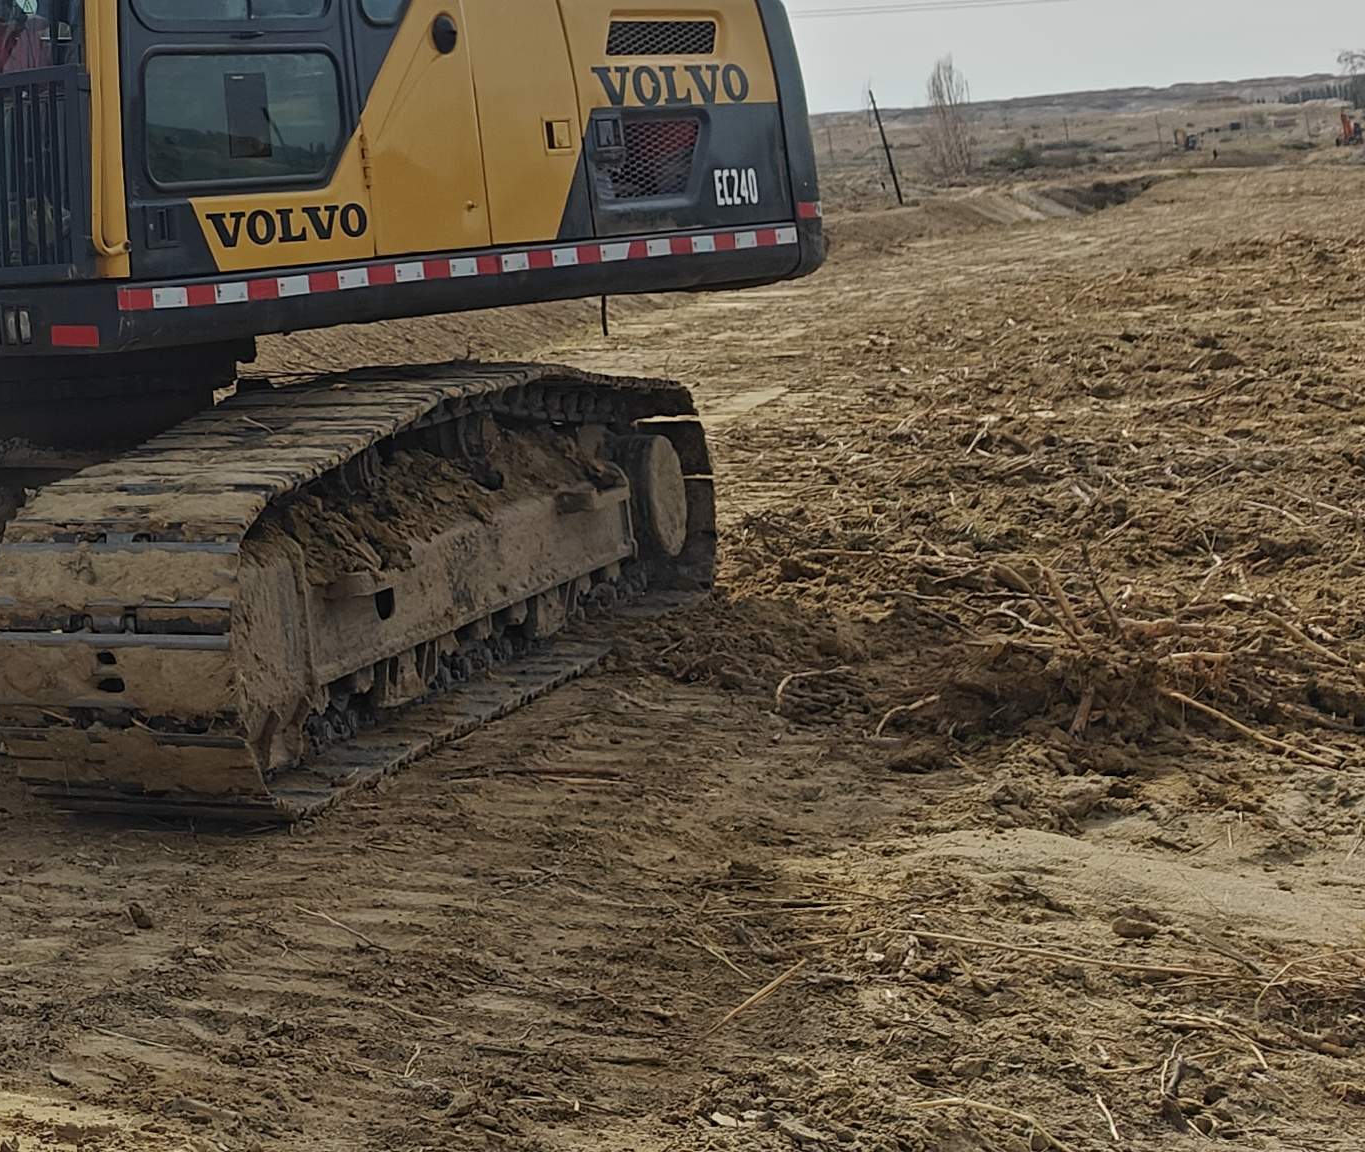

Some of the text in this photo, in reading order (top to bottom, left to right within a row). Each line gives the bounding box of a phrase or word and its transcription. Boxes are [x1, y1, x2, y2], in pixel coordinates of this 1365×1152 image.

[591, 63, 749, 106] VOLVO
[714, 168, 758, 206] EC240
[206, 203, 367, 247] VOLVO
